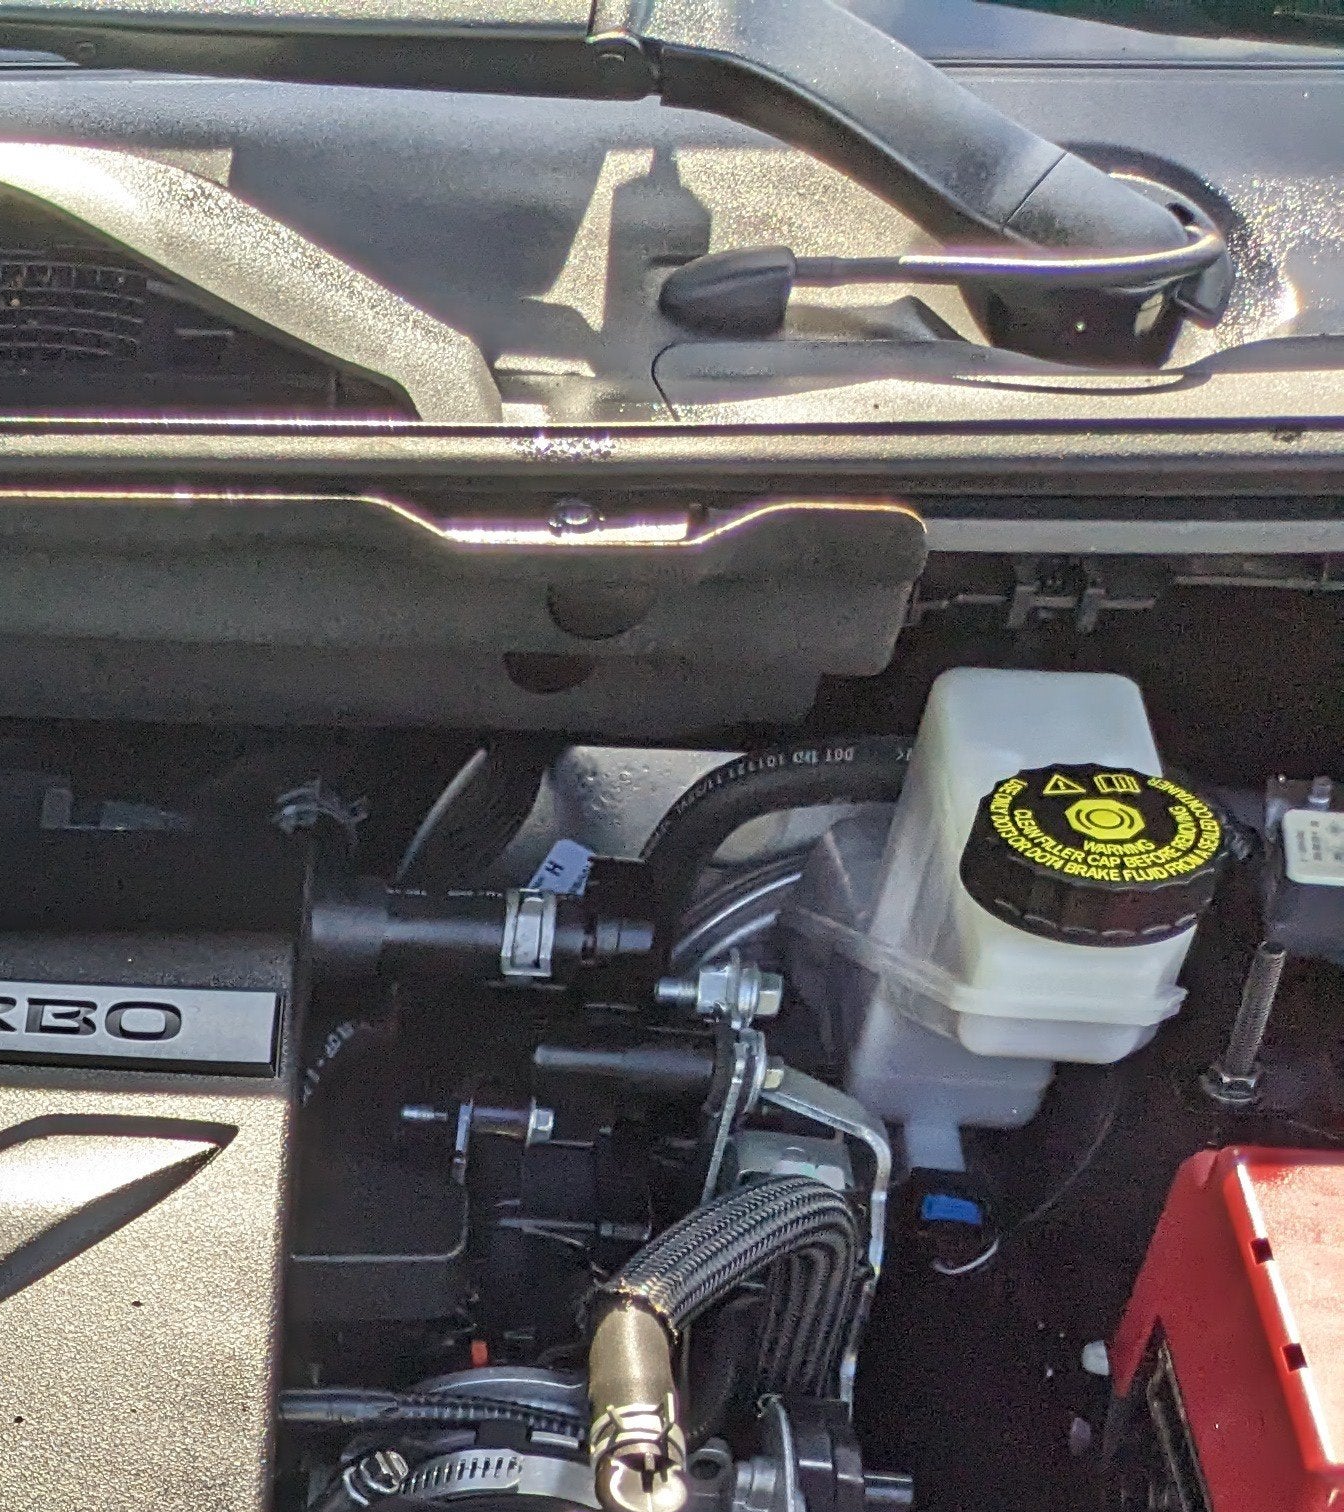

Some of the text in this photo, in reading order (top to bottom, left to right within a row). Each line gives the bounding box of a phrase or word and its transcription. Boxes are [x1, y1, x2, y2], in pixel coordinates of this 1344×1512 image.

[1147, 777, 1213, 818] CONTAINER
[1008, 836, 1032, 852] OR
[1013, 806, 1196, 867] CLEAN FILLER CAP BEFORE REMOVING
[1198, 819, 1220, 852] SEALED
[1083, 839, 1155, 855] WARNING
[1193, 849, 1212, 860] A
[1024, 847, 1065, 869] DOT4
[1164, 854, 1205, 876] FROM
[1064, 862, 1120, 881] BRAKE
[1123, 867, 1169, 881] FLUID
